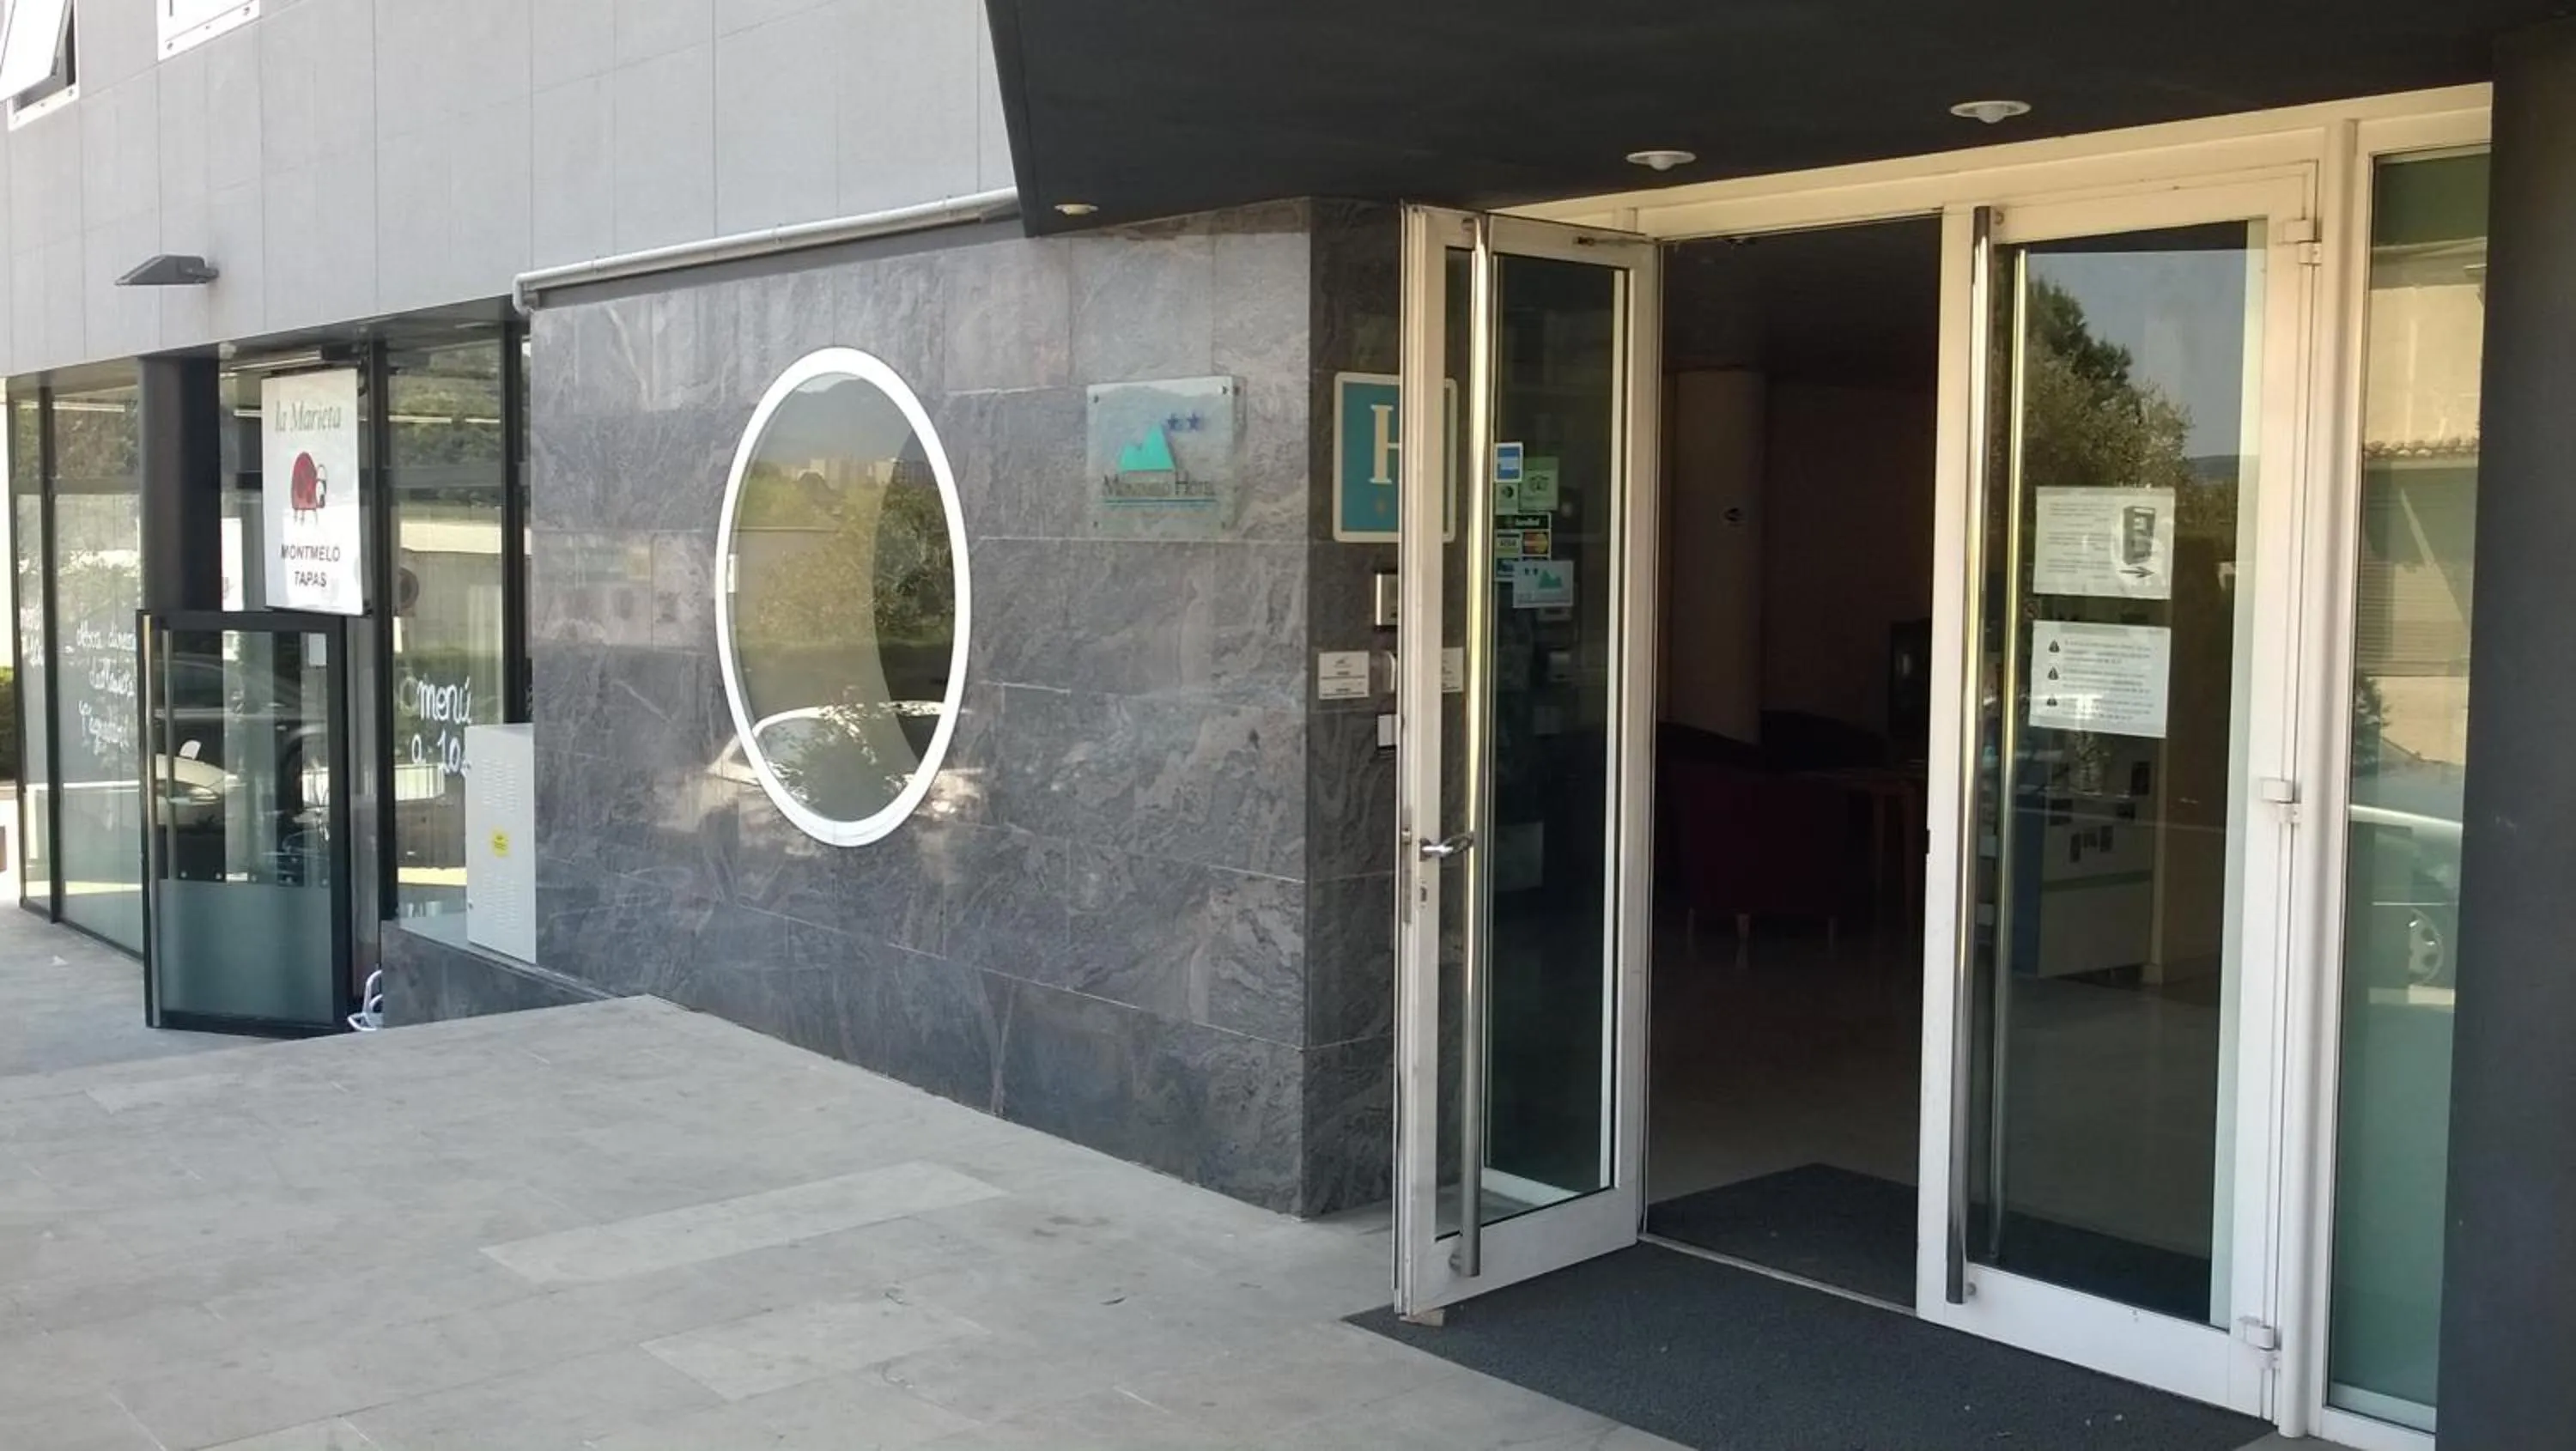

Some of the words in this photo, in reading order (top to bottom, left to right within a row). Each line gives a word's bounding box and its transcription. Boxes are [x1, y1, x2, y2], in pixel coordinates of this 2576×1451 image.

[274, 400, 287, 433] la
[289, 401, 342, 431] Marieta
[280, 543, 341, 562] MONTMELO
[294, 571, 327, 588] TAPAS
[416, 675, 471, 725] menú
